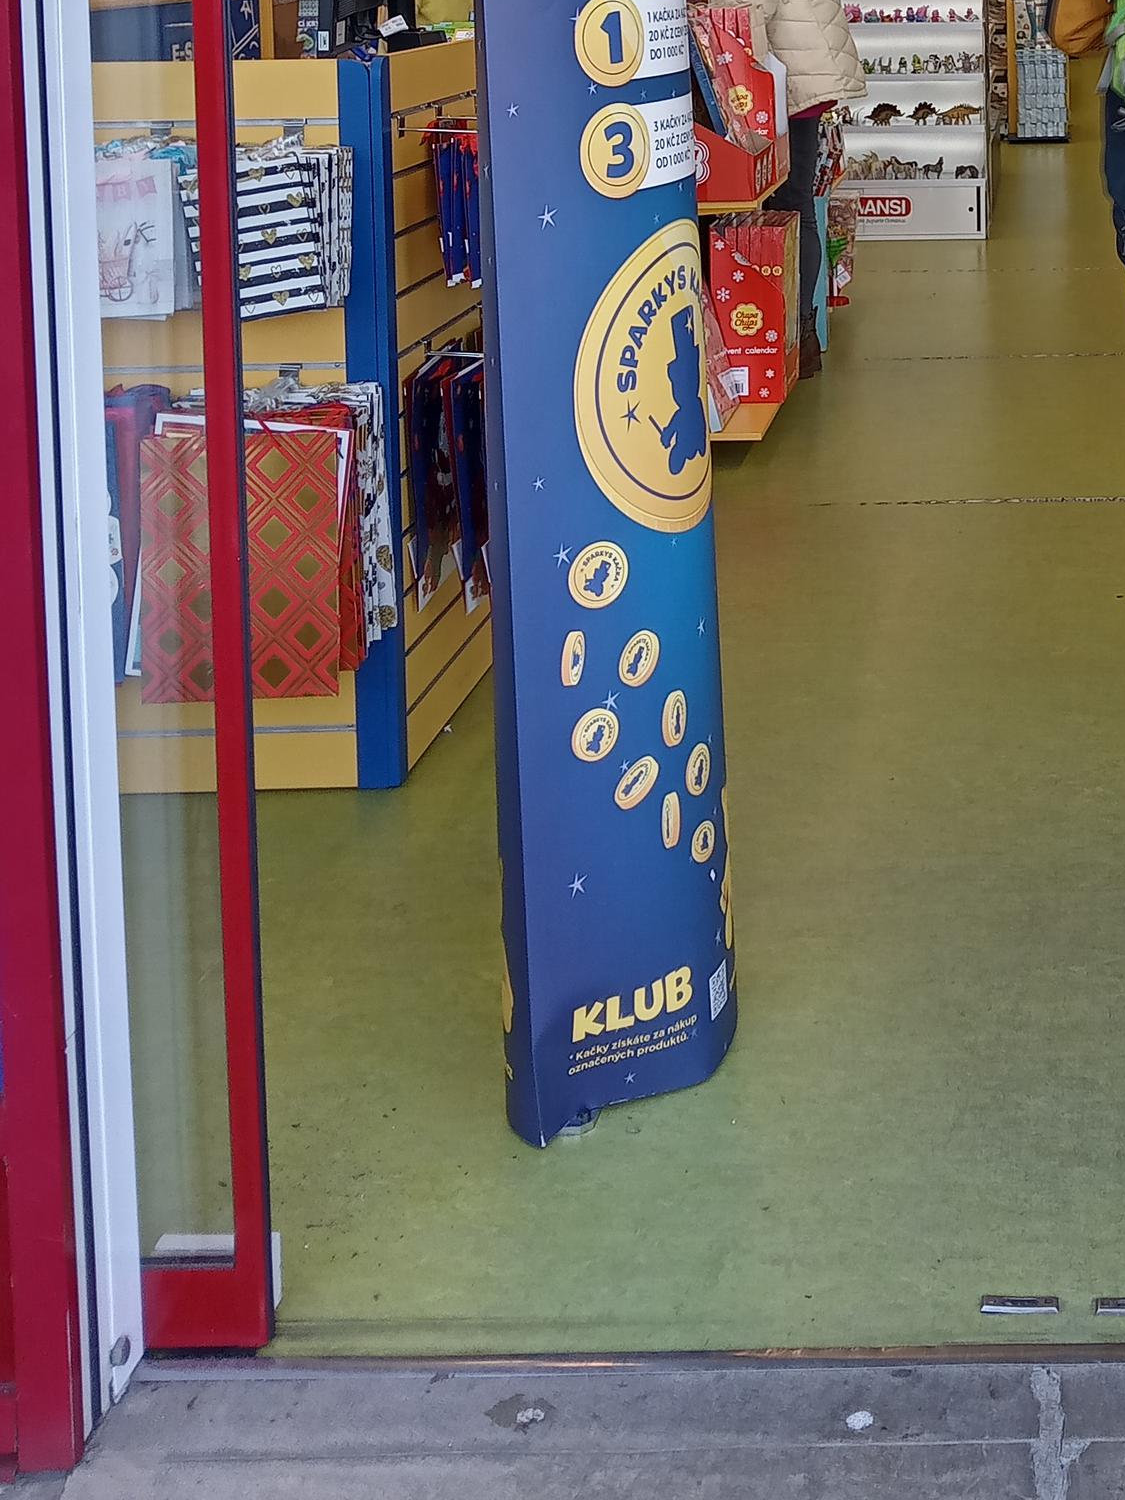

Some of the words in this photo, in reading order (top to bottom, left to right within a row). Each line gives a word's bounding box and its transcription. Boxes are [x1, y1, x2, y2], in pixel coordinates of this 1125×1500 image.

[600, 11, 624, 65] 1
[649, 30, 659, 42] 20
[650, 48, 662, 60] DO
[604, 121, 635, 179] 3
[655, 138, 665, 150] 20
[656, 156, 668, 169] OD
[617, 265, 687, 394] SPARKYS
[745, 346, 778, 355] calendar
[572, 966, 694, 1044] KLUB
[575, 1043, 611, 1061] Kačky
[653, 1030, 665, 1040] za
[667, 1014, 698, 1035] nákup
[637, 1031, 689, 1057] produktů.
